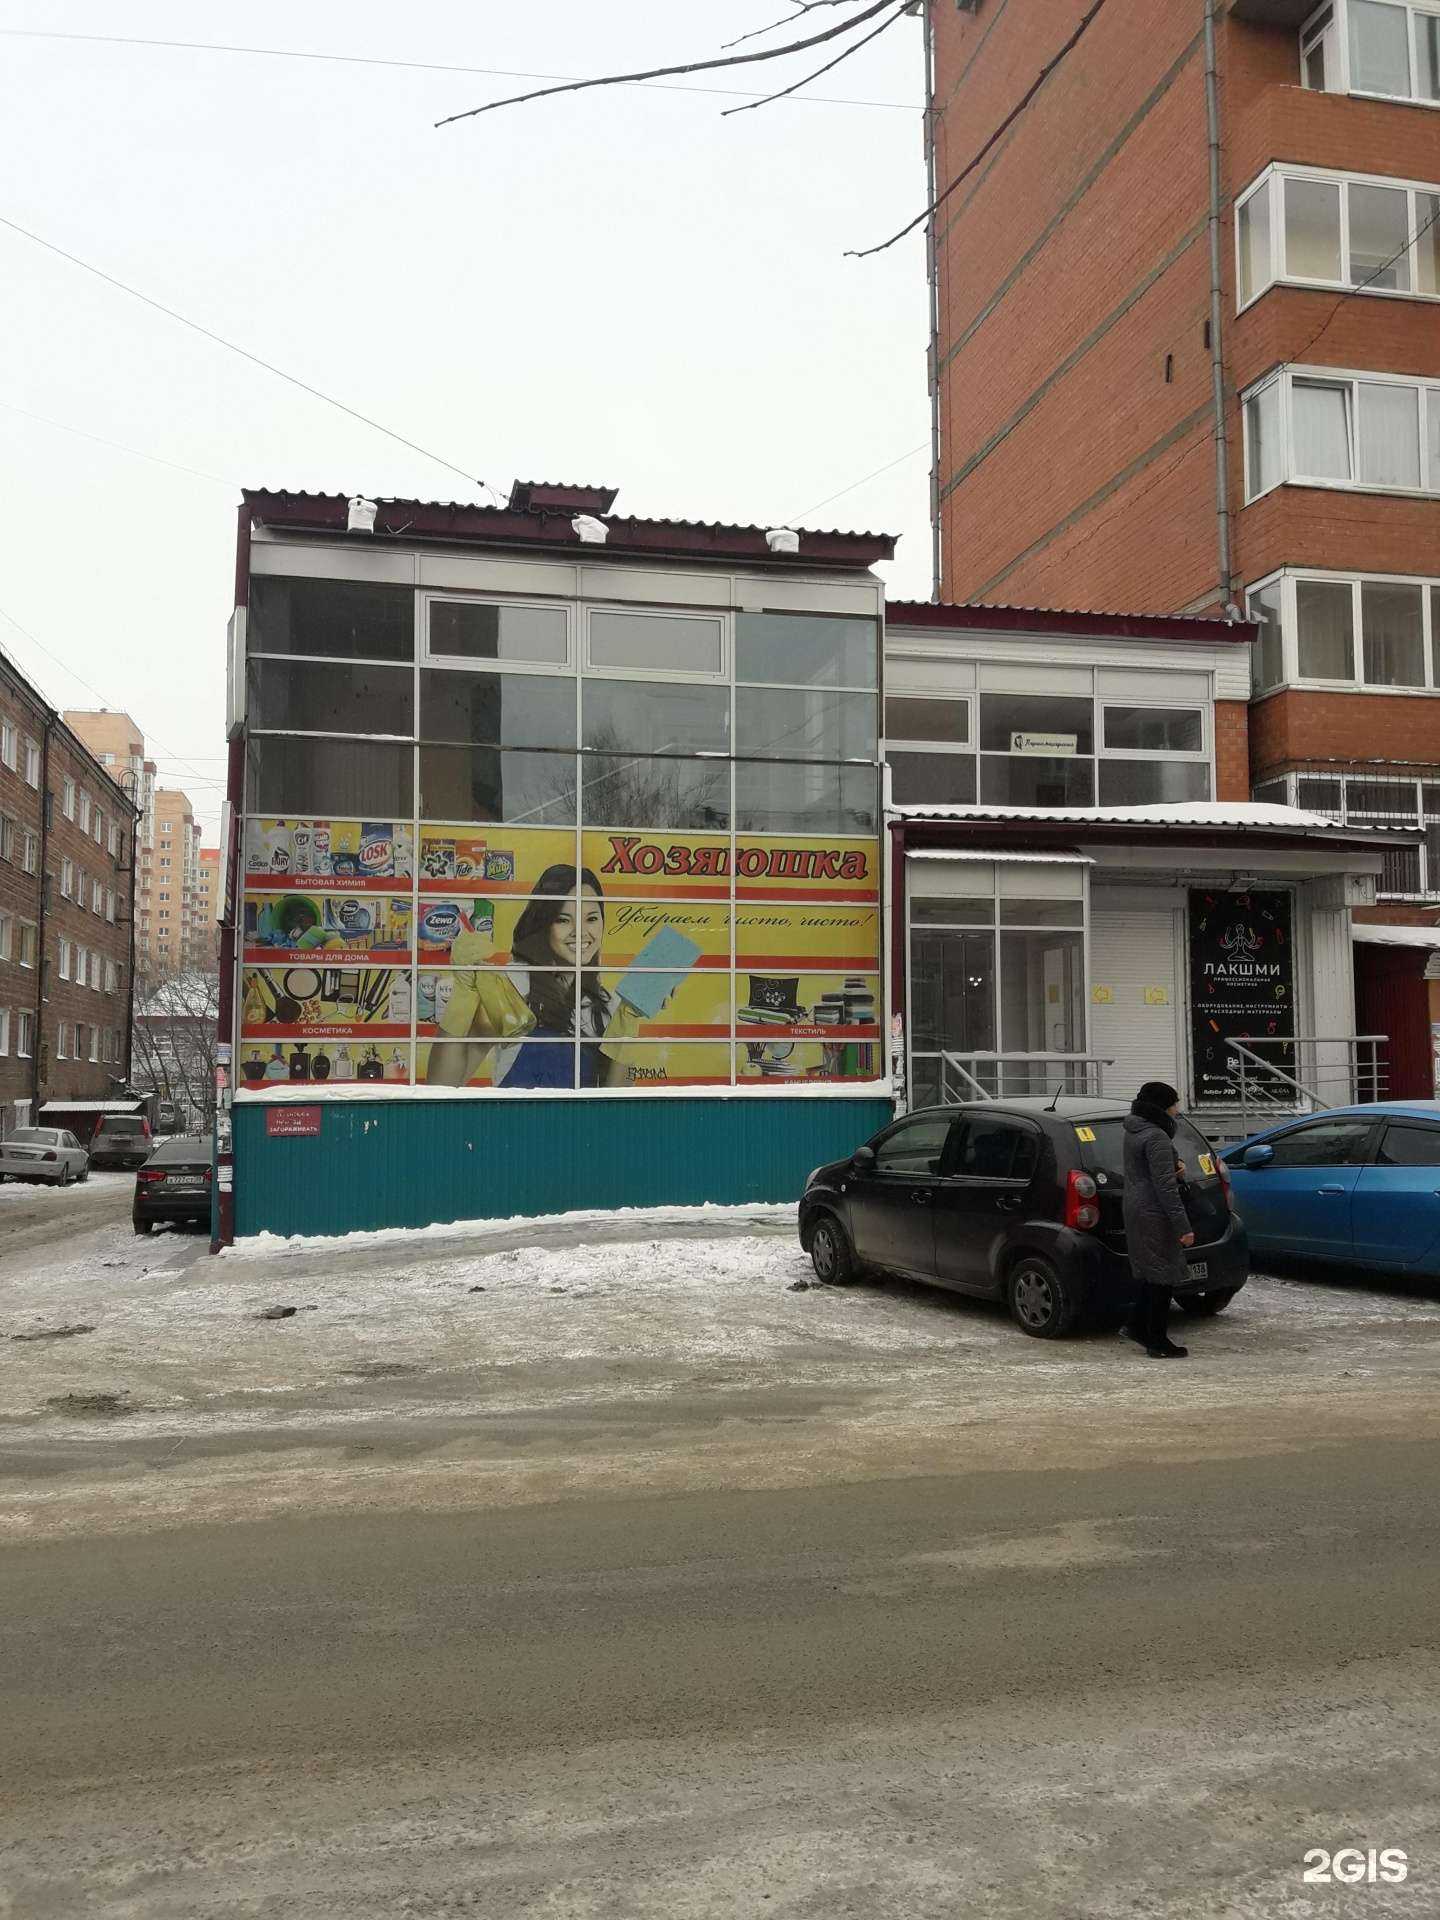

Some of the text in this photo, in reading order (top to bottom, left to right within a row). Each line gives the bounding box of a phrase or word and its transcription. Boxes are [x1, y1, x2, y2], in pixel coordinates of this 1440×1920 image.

[361, 843, 388, 862] LOSK
[601, 836, 868, 880] Хозяюшка
[295, 878, 366, 887] БЫТОВАЯ ХИМИЯ
[430, 915, 453, 925] Zewa
[608, 905, 710, 937] Убираем
[288, 953, 370, 962] ТОВАРЫ ДЛЯ ДОМА
[1203, 962, 1281, 976] ЛАКШМИ
[302, 1027, 353, 1035] КОСМЕТИКА
[790, 1027, 826, 1035] ТЕКСТИЛЬ
